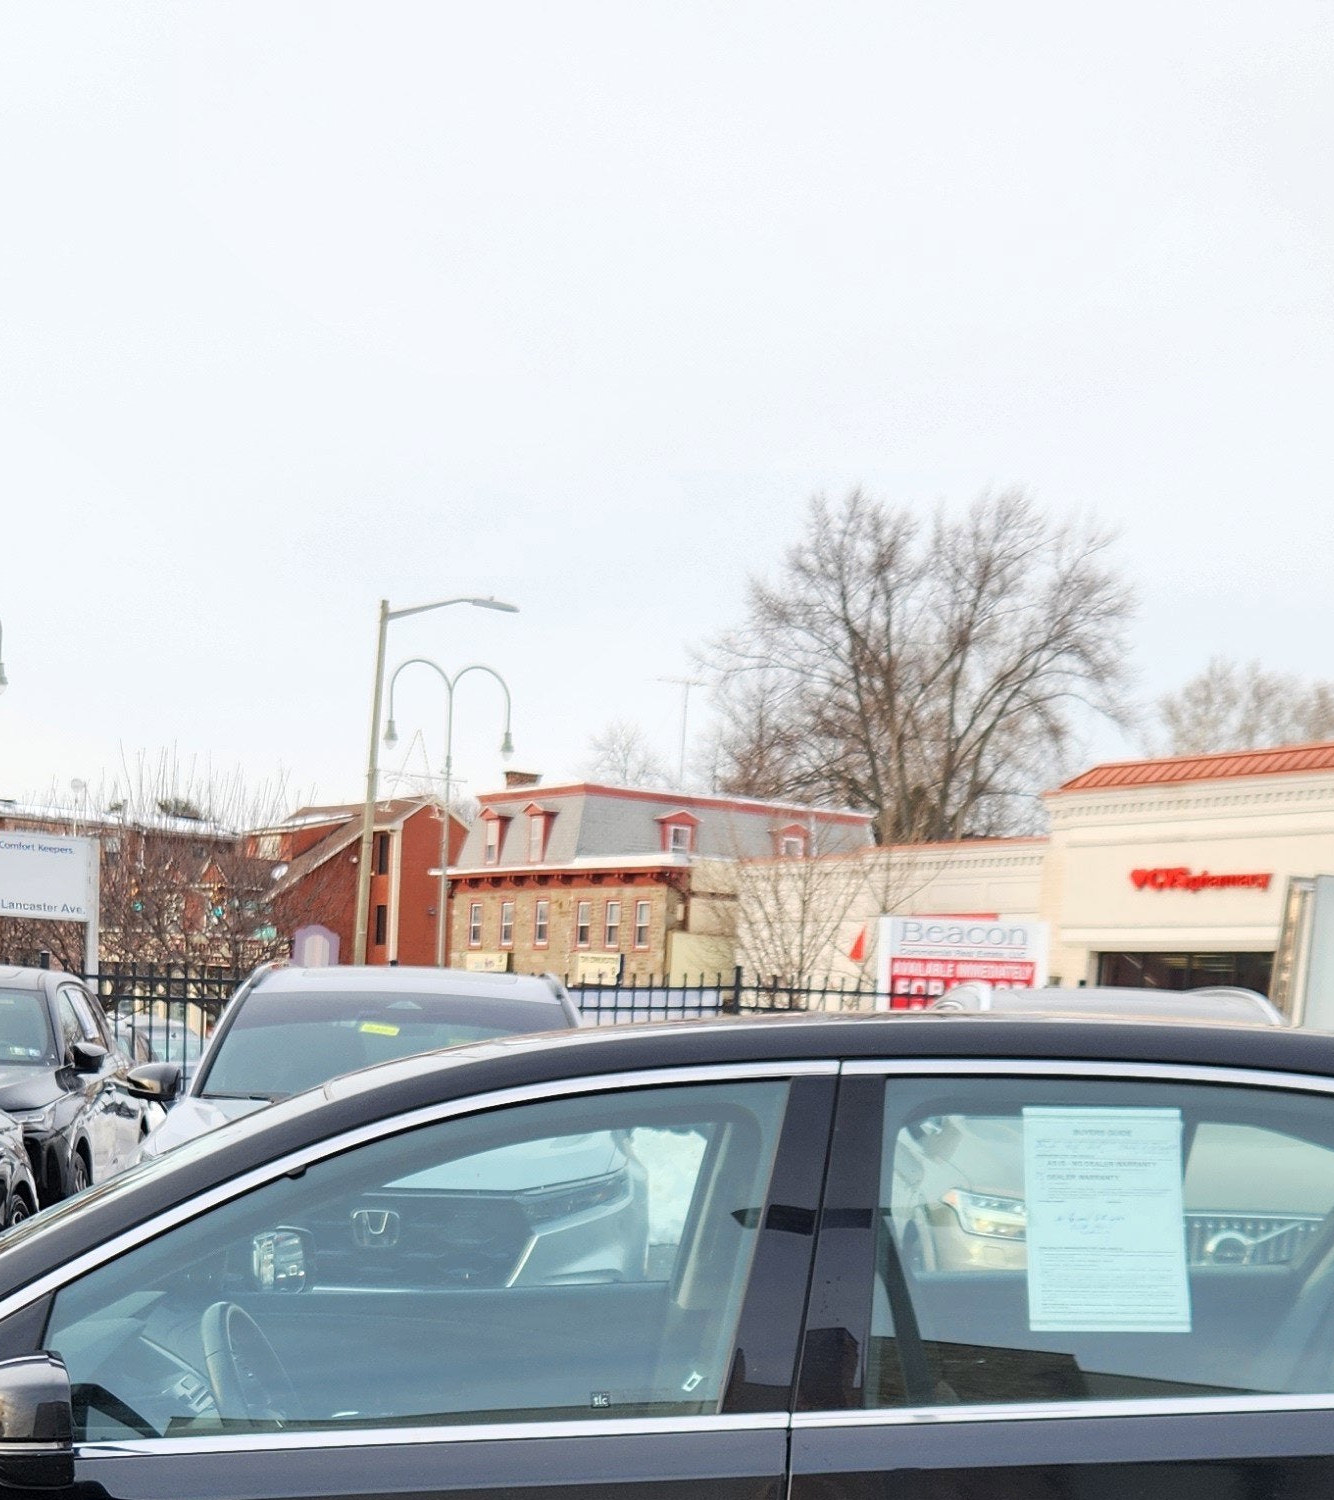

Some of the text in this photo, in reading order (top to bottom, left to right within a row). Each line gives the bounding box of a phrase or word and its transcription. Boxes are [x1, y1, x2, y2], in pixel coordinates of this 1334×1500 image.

[0, 841, 35, 851] Comfort
[1, 899, 58, 912] Lancaster
[61, 903, 86, 915] Ave.
[900, 921, 1028, 945] Beacon
[892, 961, 1034, 980] AVAILABLE IMMEDIATELY
